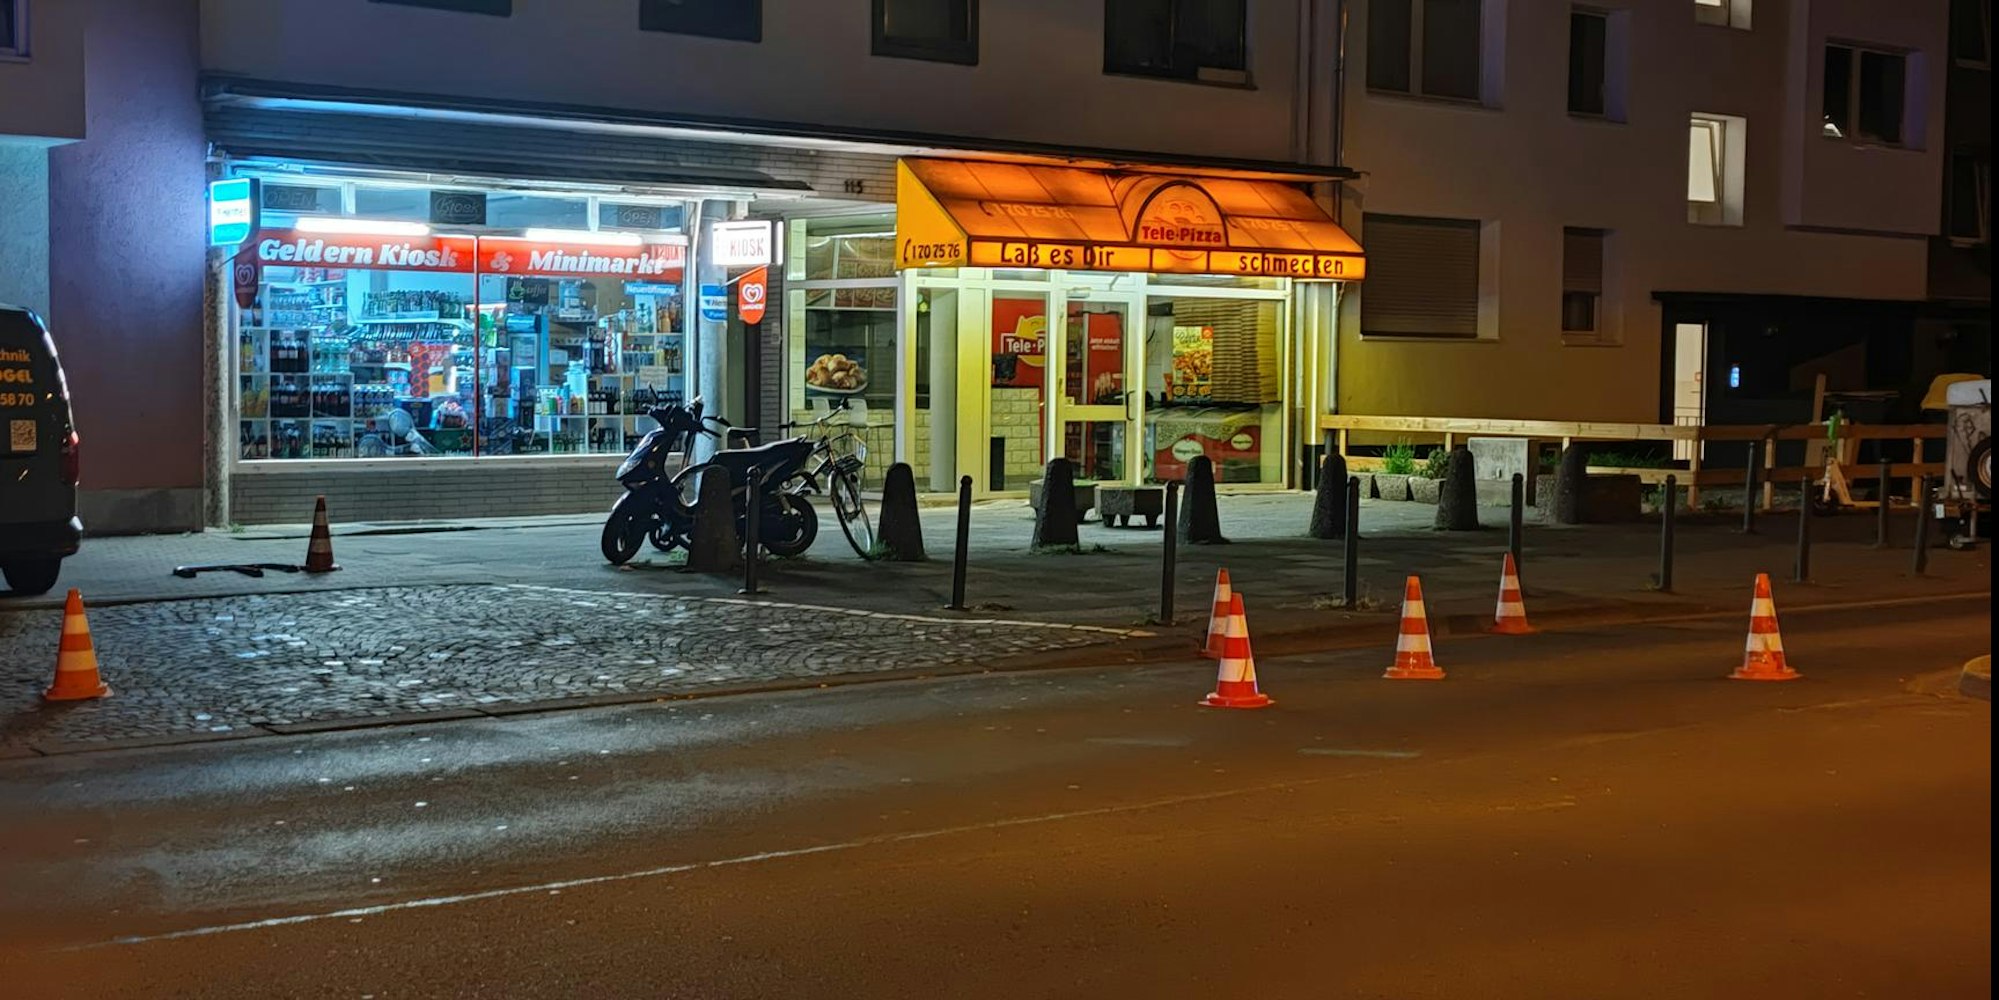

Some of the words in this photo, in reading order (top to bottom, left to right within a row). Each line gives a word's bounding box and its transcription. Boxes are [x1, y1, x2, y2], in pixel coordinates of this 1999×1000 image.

[844, 180, 864, 194] 115
[730, 237, 765, 258] KIOSK
[258, 238, 374, 266] Geldern
[377, 243, 458, 268] Kiosk
[490, 250, 513, 272] &
[527, 249, 667, 275] Minimarkt
[1001, 242, 1038, 265] Laß
[1050, 248, 1073, 266] es
[1083, 245, 1115, 267] Dir
[1239, 253, 1344, 276] schmecken
[0, 369, 33, 383] GEL
[19, 393, 34, 406] 70
